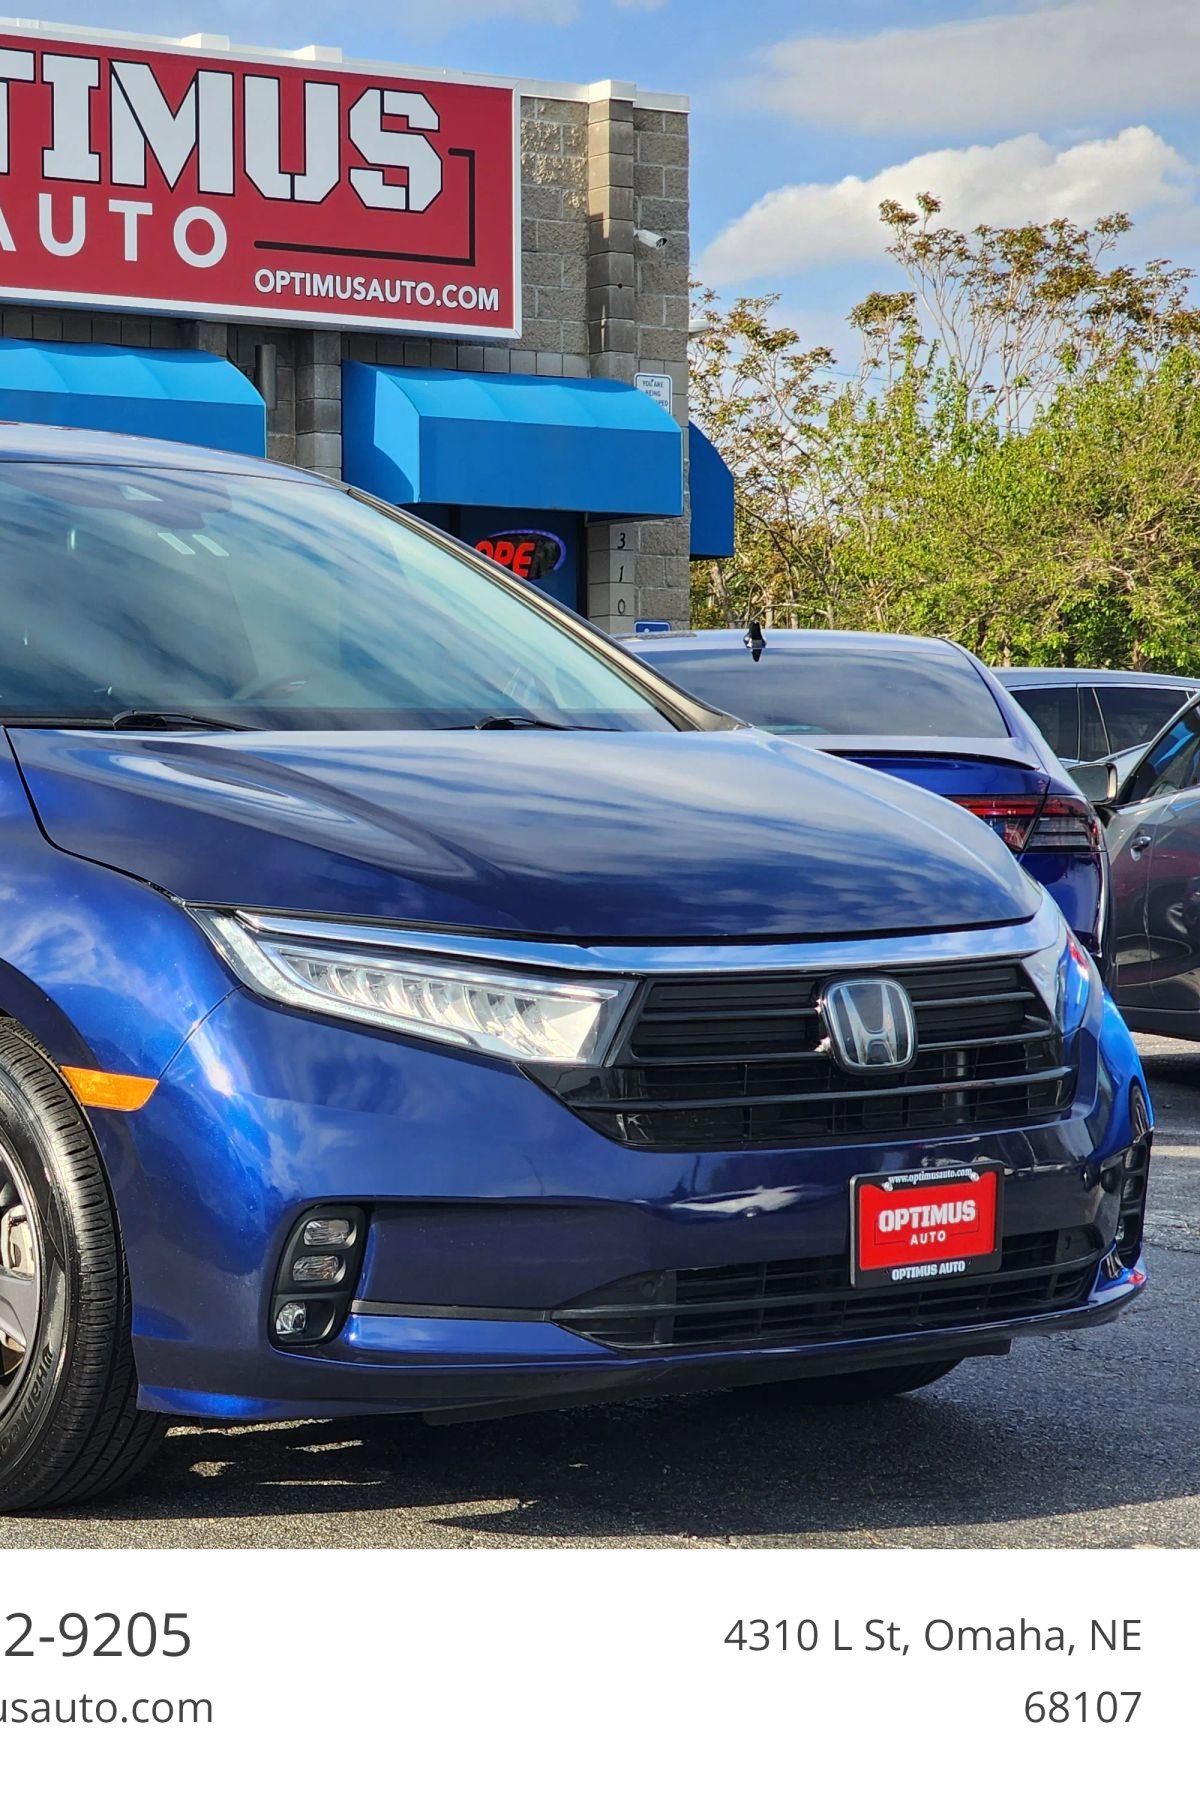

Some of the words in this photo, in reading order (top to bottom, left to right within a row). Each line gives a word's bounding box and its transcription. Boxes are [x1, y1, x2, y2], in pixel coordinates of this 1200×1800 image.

[253, 268, 500, 312] OPTIMUSAUTO.COM
[888, 1168, 972, 1185] www.optimusauto.com
[879, 1200, 976, 1233] OPTIMUS
[910, 1230, 947, 1246] AUTO
[891, 1264, 938, 1281] OPTIMUS
[938, 1260, 966, 1275] AUTO
